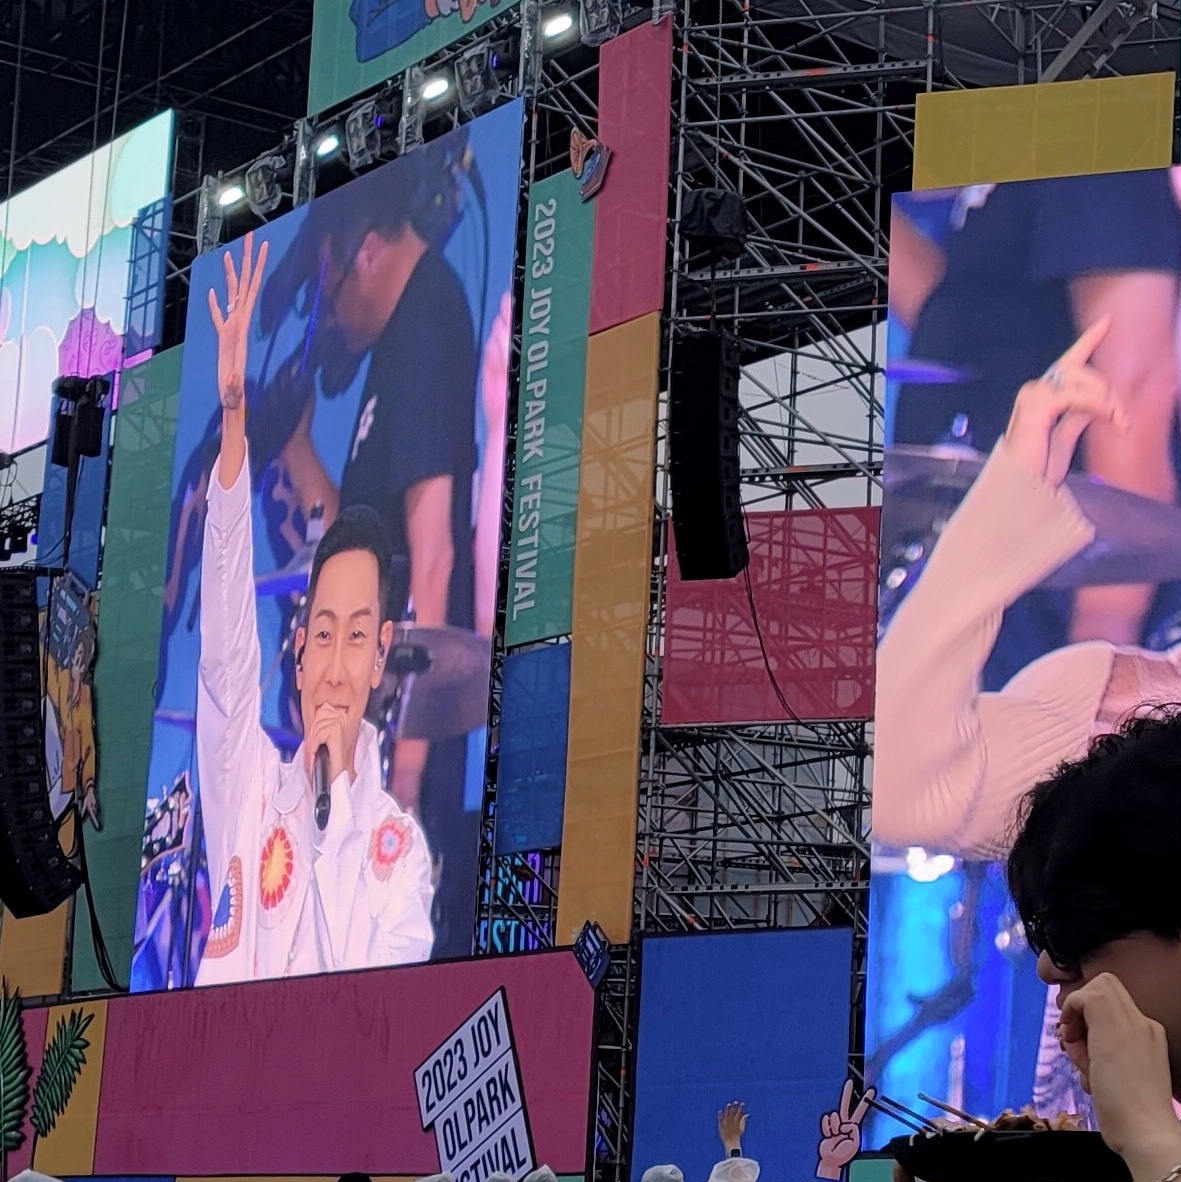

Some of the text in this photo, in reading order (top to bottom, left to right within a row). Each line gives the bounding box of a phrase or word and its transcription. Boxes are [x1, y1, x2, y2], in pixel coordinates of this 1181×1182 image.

[512, 197, 557, 622] 2023 JOY OLPARK FESTIVAL
[421, 1001, 502, 1115] 2023 JOY
[442, 1061, 517, 1162] OLPARK
